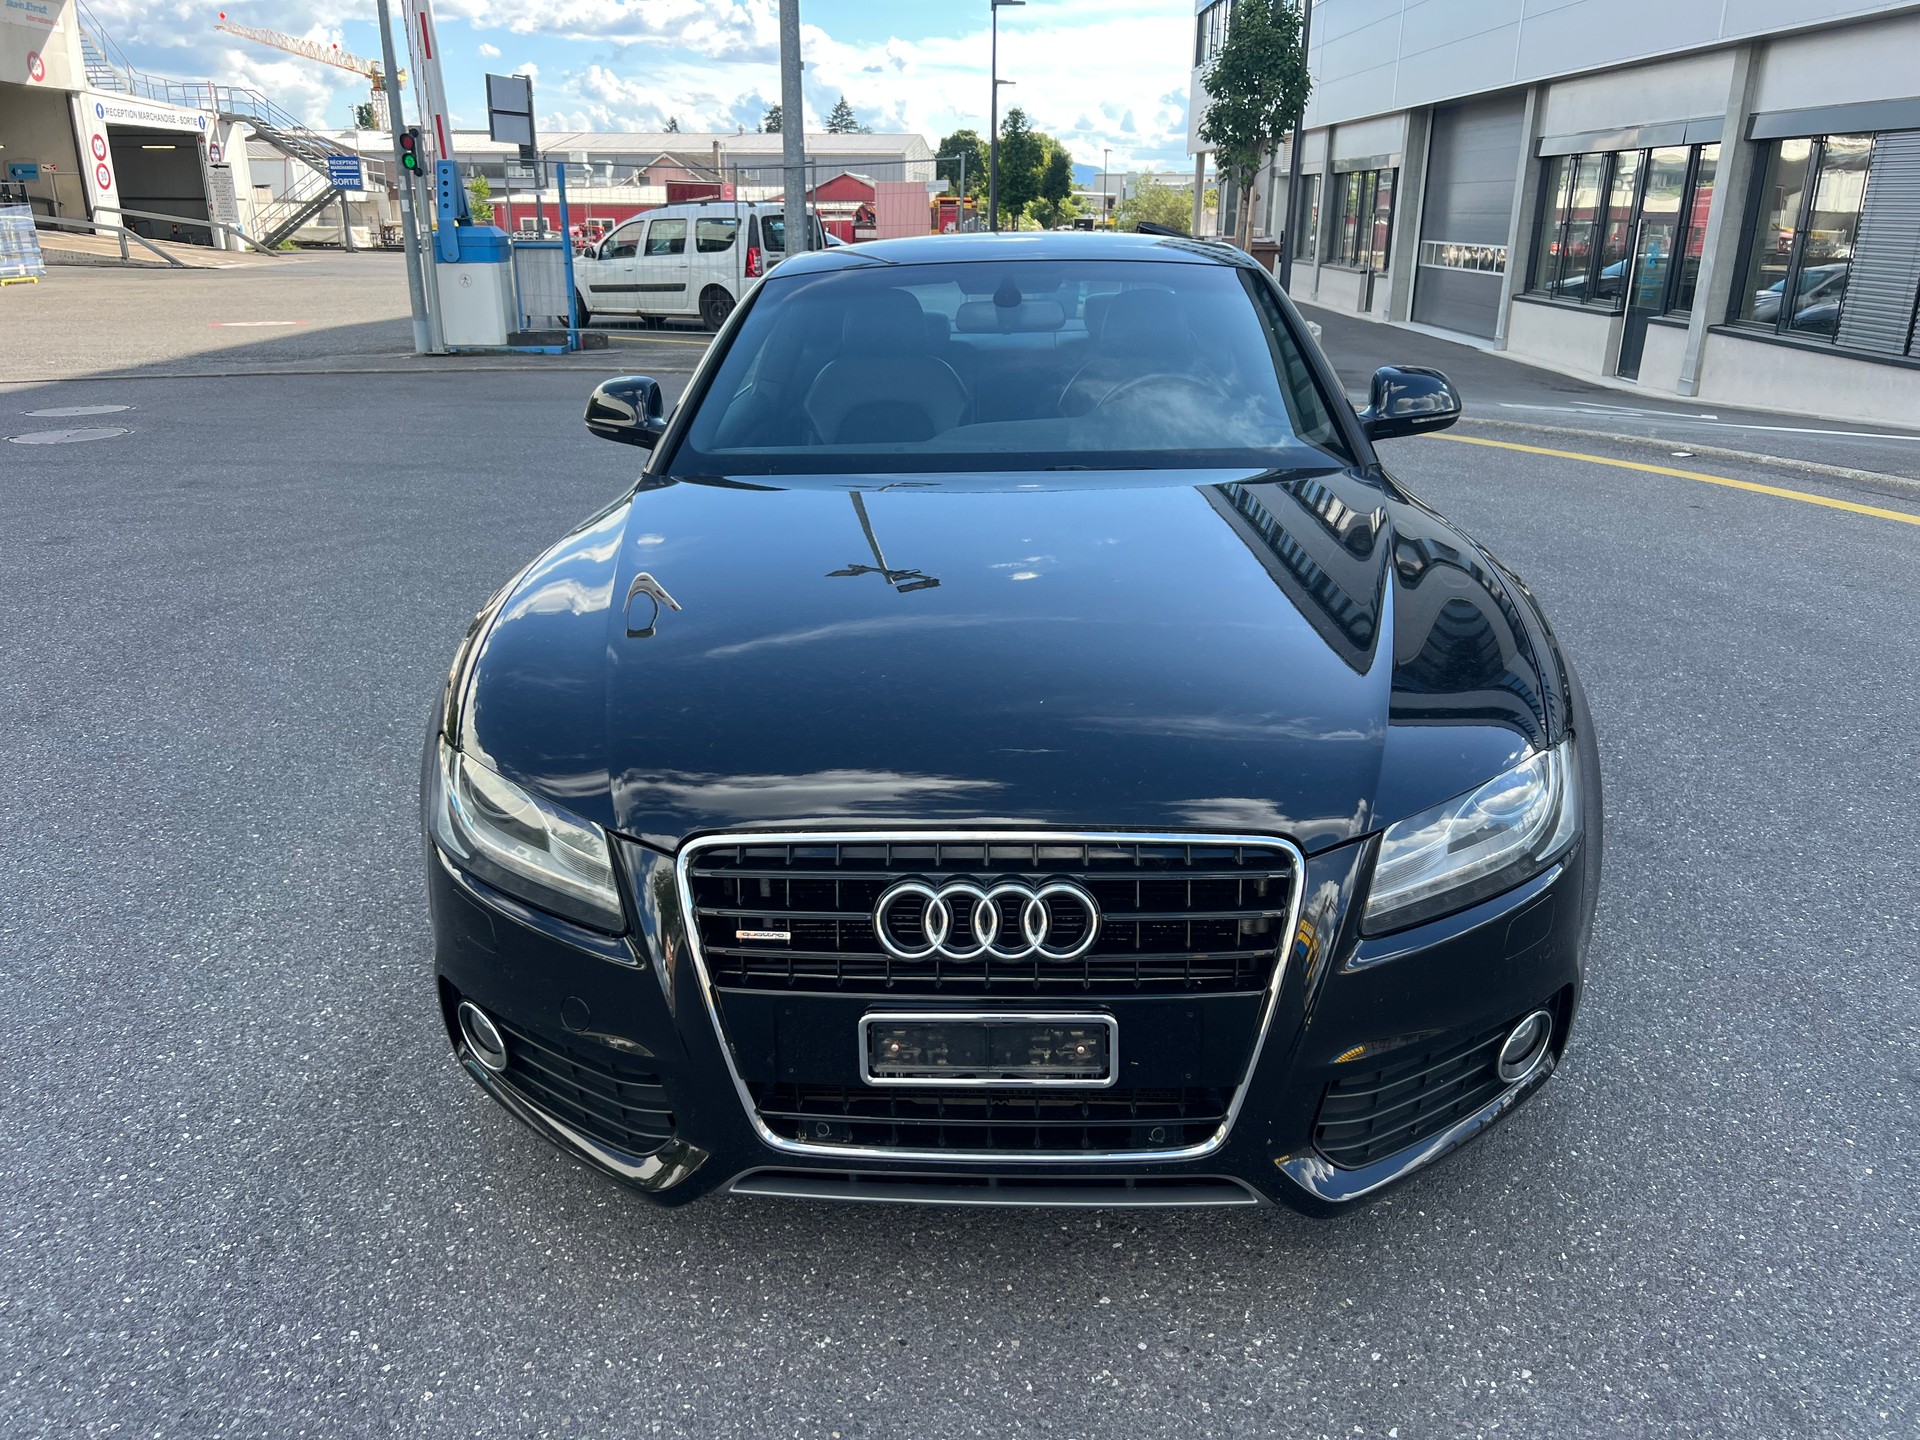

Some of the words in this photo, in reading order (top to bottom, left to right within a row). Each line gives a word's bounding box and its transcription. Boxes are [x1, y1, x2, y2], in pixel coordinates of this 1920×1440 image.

[105, 107, 137, 119] RECEPTION
[138, 111, 176, 124] MARCHANDISE
[180, 116, 198, 126] SORTIE
[332, 178, 361, 186] SORTIE
